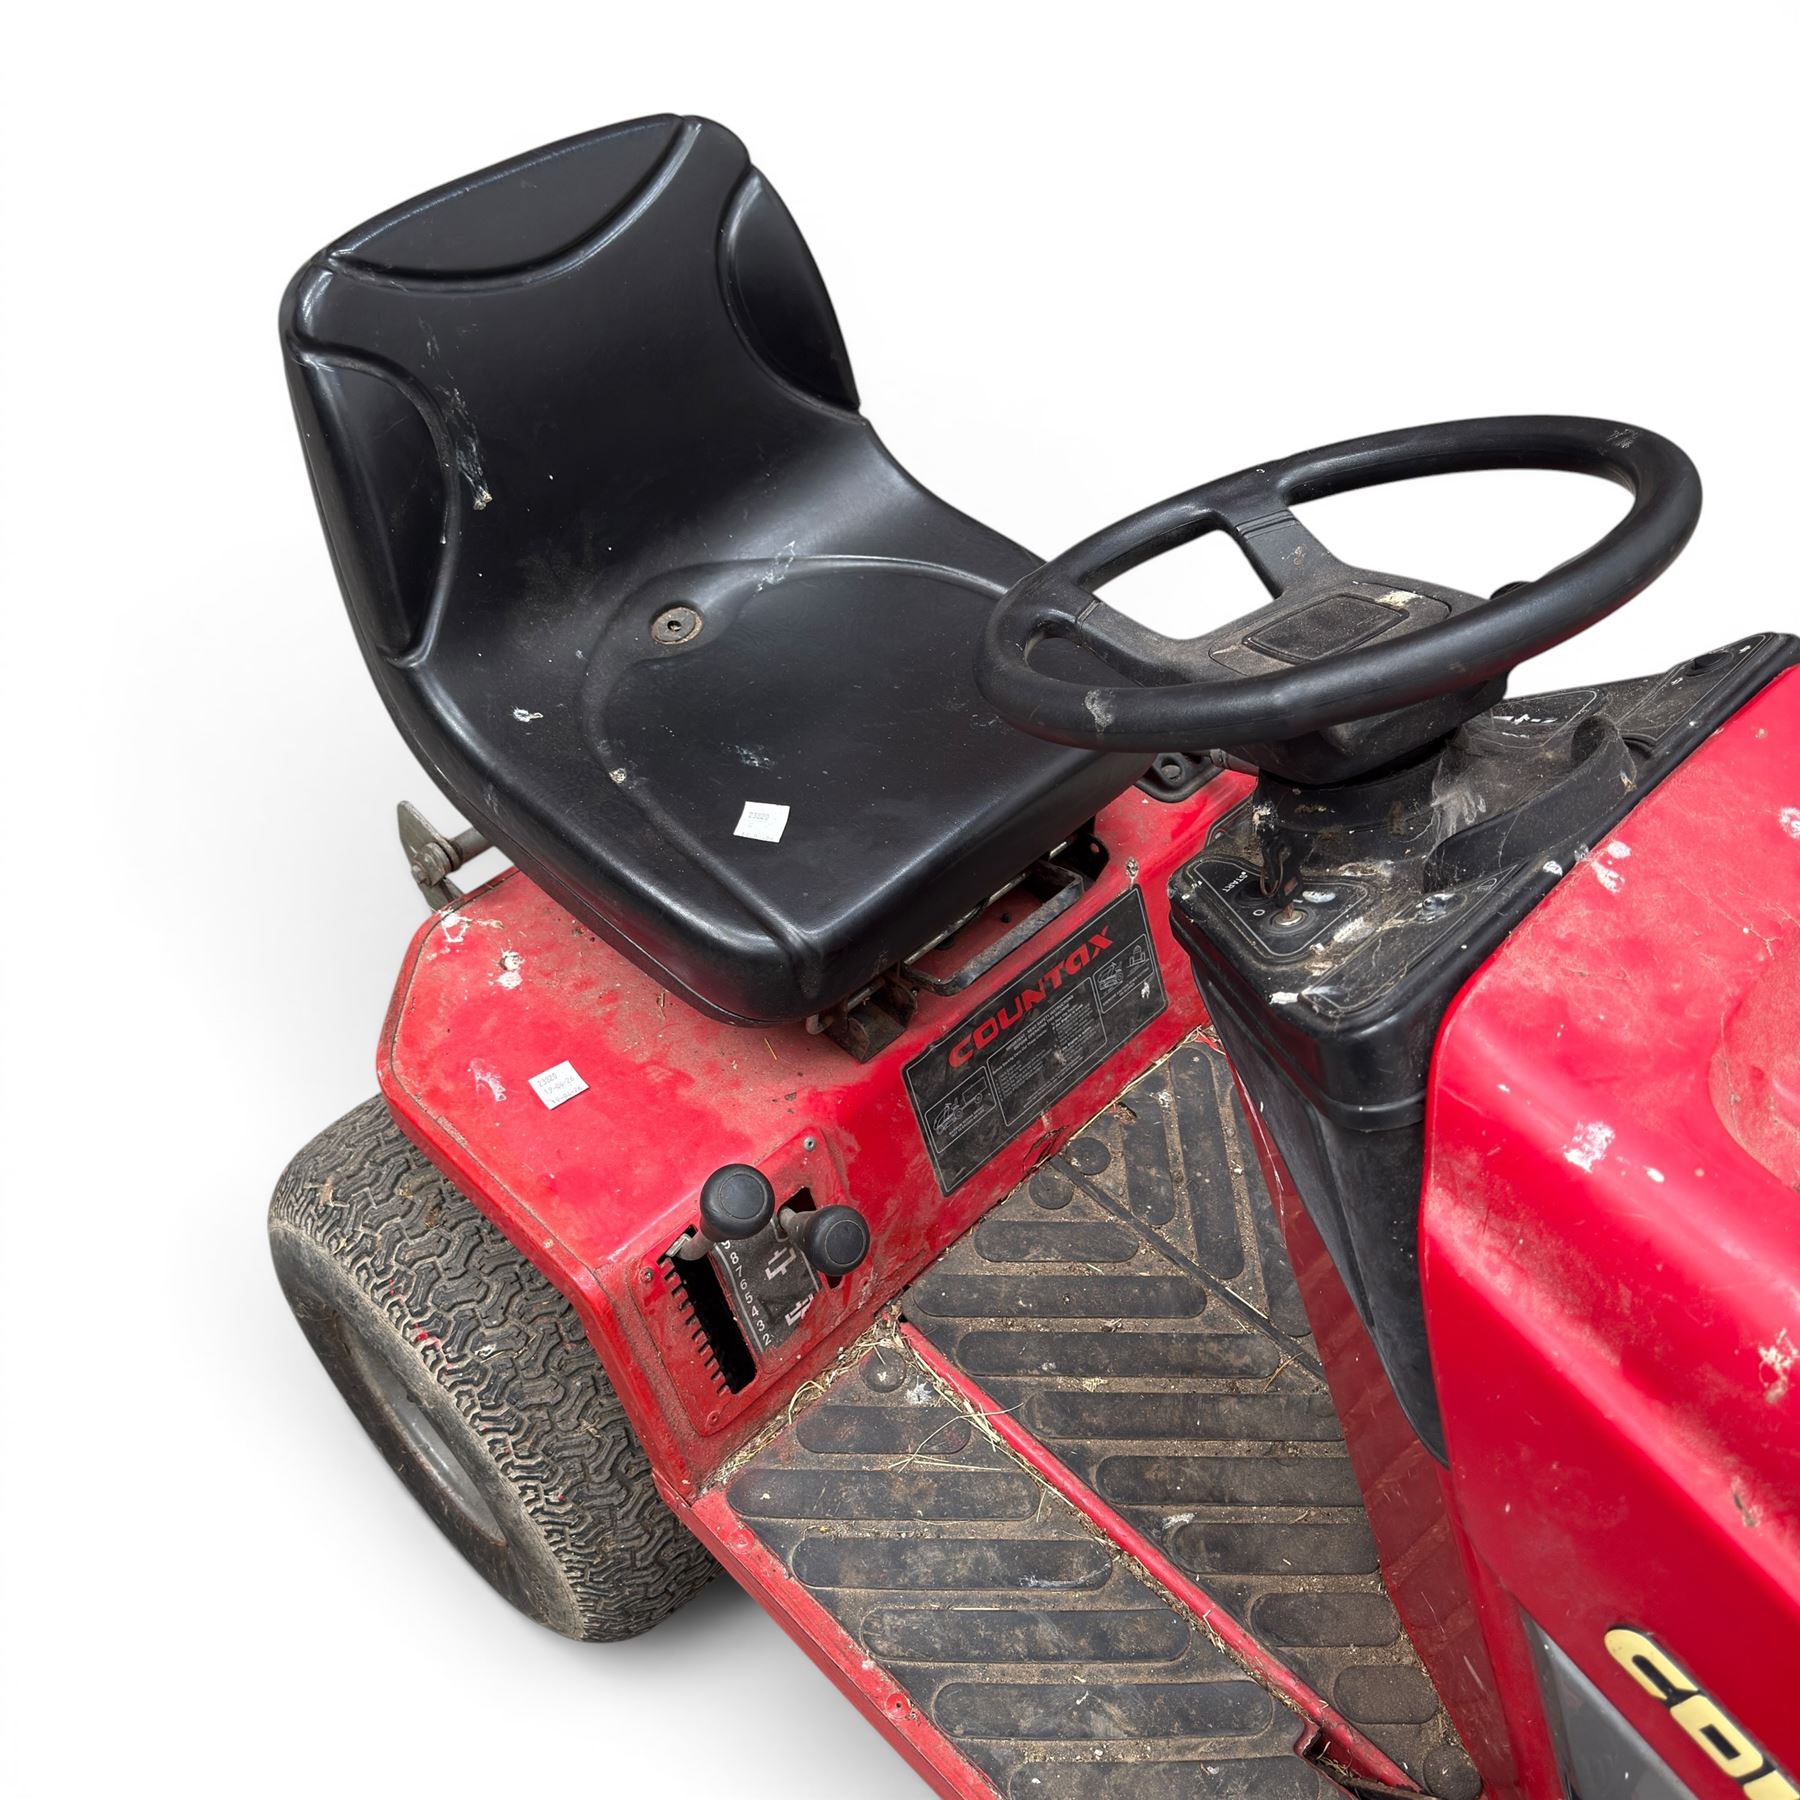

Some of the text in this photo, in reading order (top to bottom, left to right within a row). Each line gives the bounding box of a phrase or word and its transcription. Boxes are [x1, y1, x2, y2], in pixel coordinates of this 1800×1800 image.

[1222, 871, 1248, 892] START
[948, 928, 1115, 1068] COUNTAX
[730, 1252, 739, 1265] 8
[735, 1265, 743, 1277] 7
[740, 1278, 748, 1290] 6
[745, 1292, 753, 1304] 5
[751, 1305, 759, 1317] 4
[756, 1319, 765, 1332] 3
[762, 1333, 772, 1346] 2
